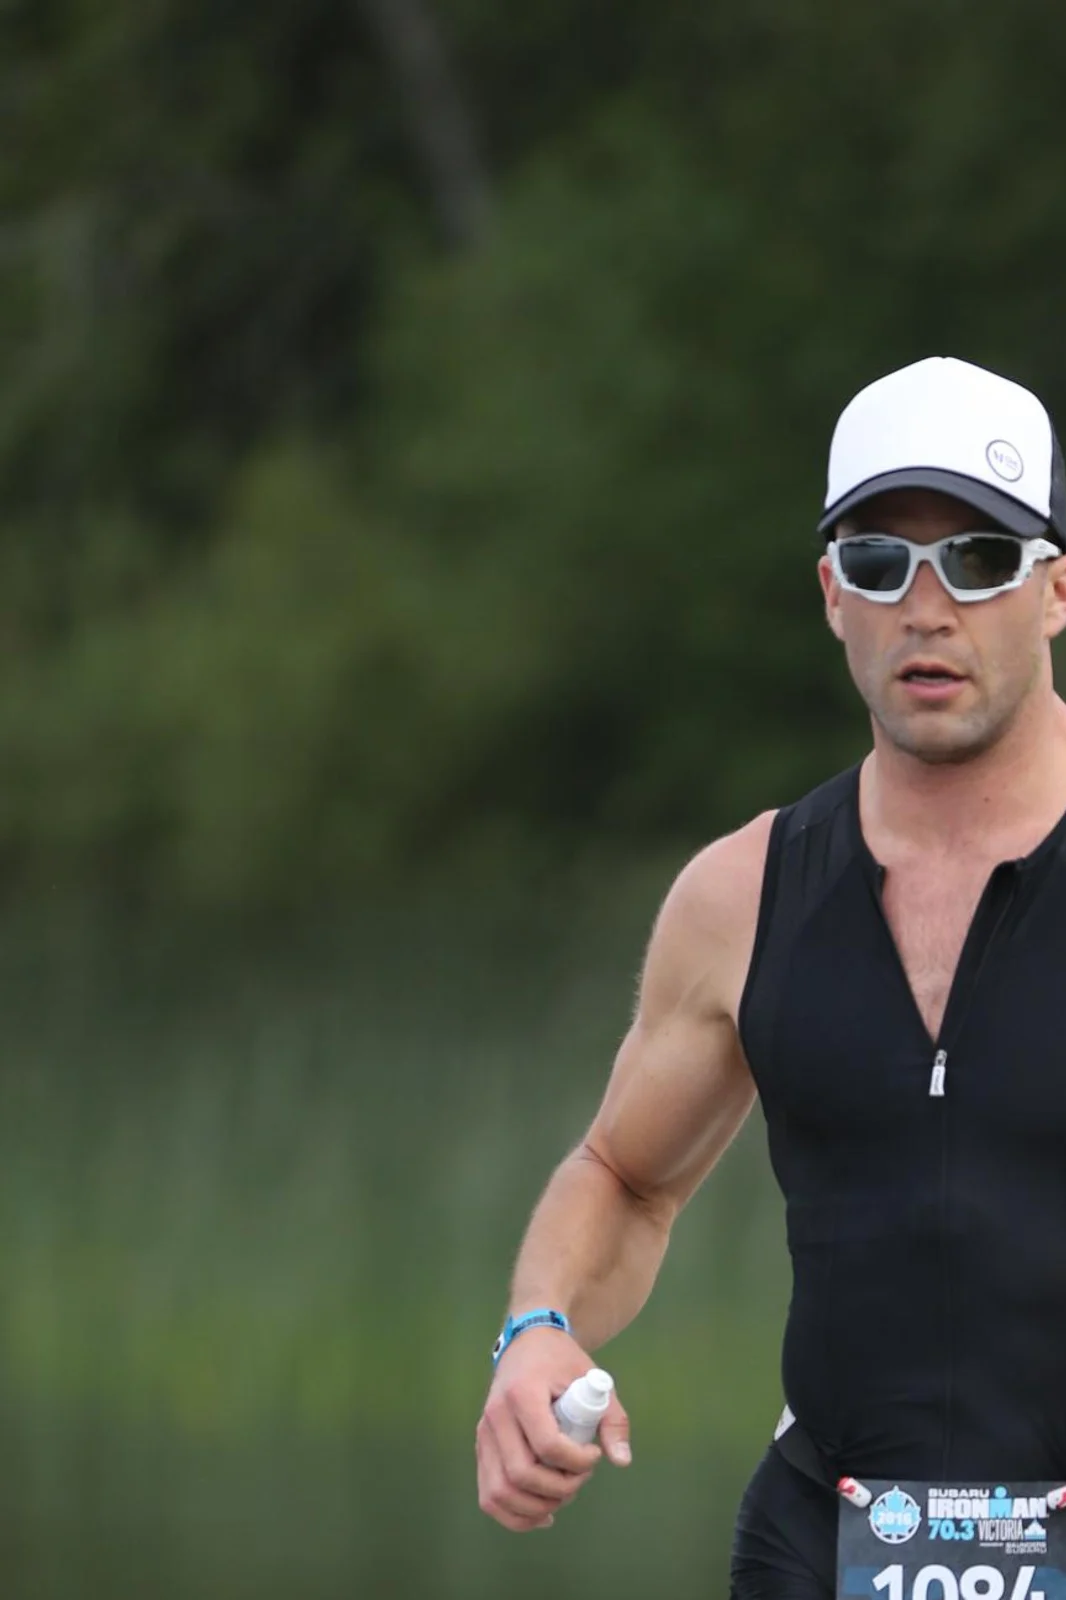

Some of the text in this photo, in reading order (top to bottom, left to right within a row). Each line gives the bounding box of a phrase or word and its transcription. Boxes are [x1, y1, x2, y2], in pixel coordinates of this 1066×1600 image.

[928, 1488, 990, 1498] SUBARU
[928, 1497, 1047, 1519] IRONMAN
[928, 1519, 1024, 1541] 70.3 VICTORIA
